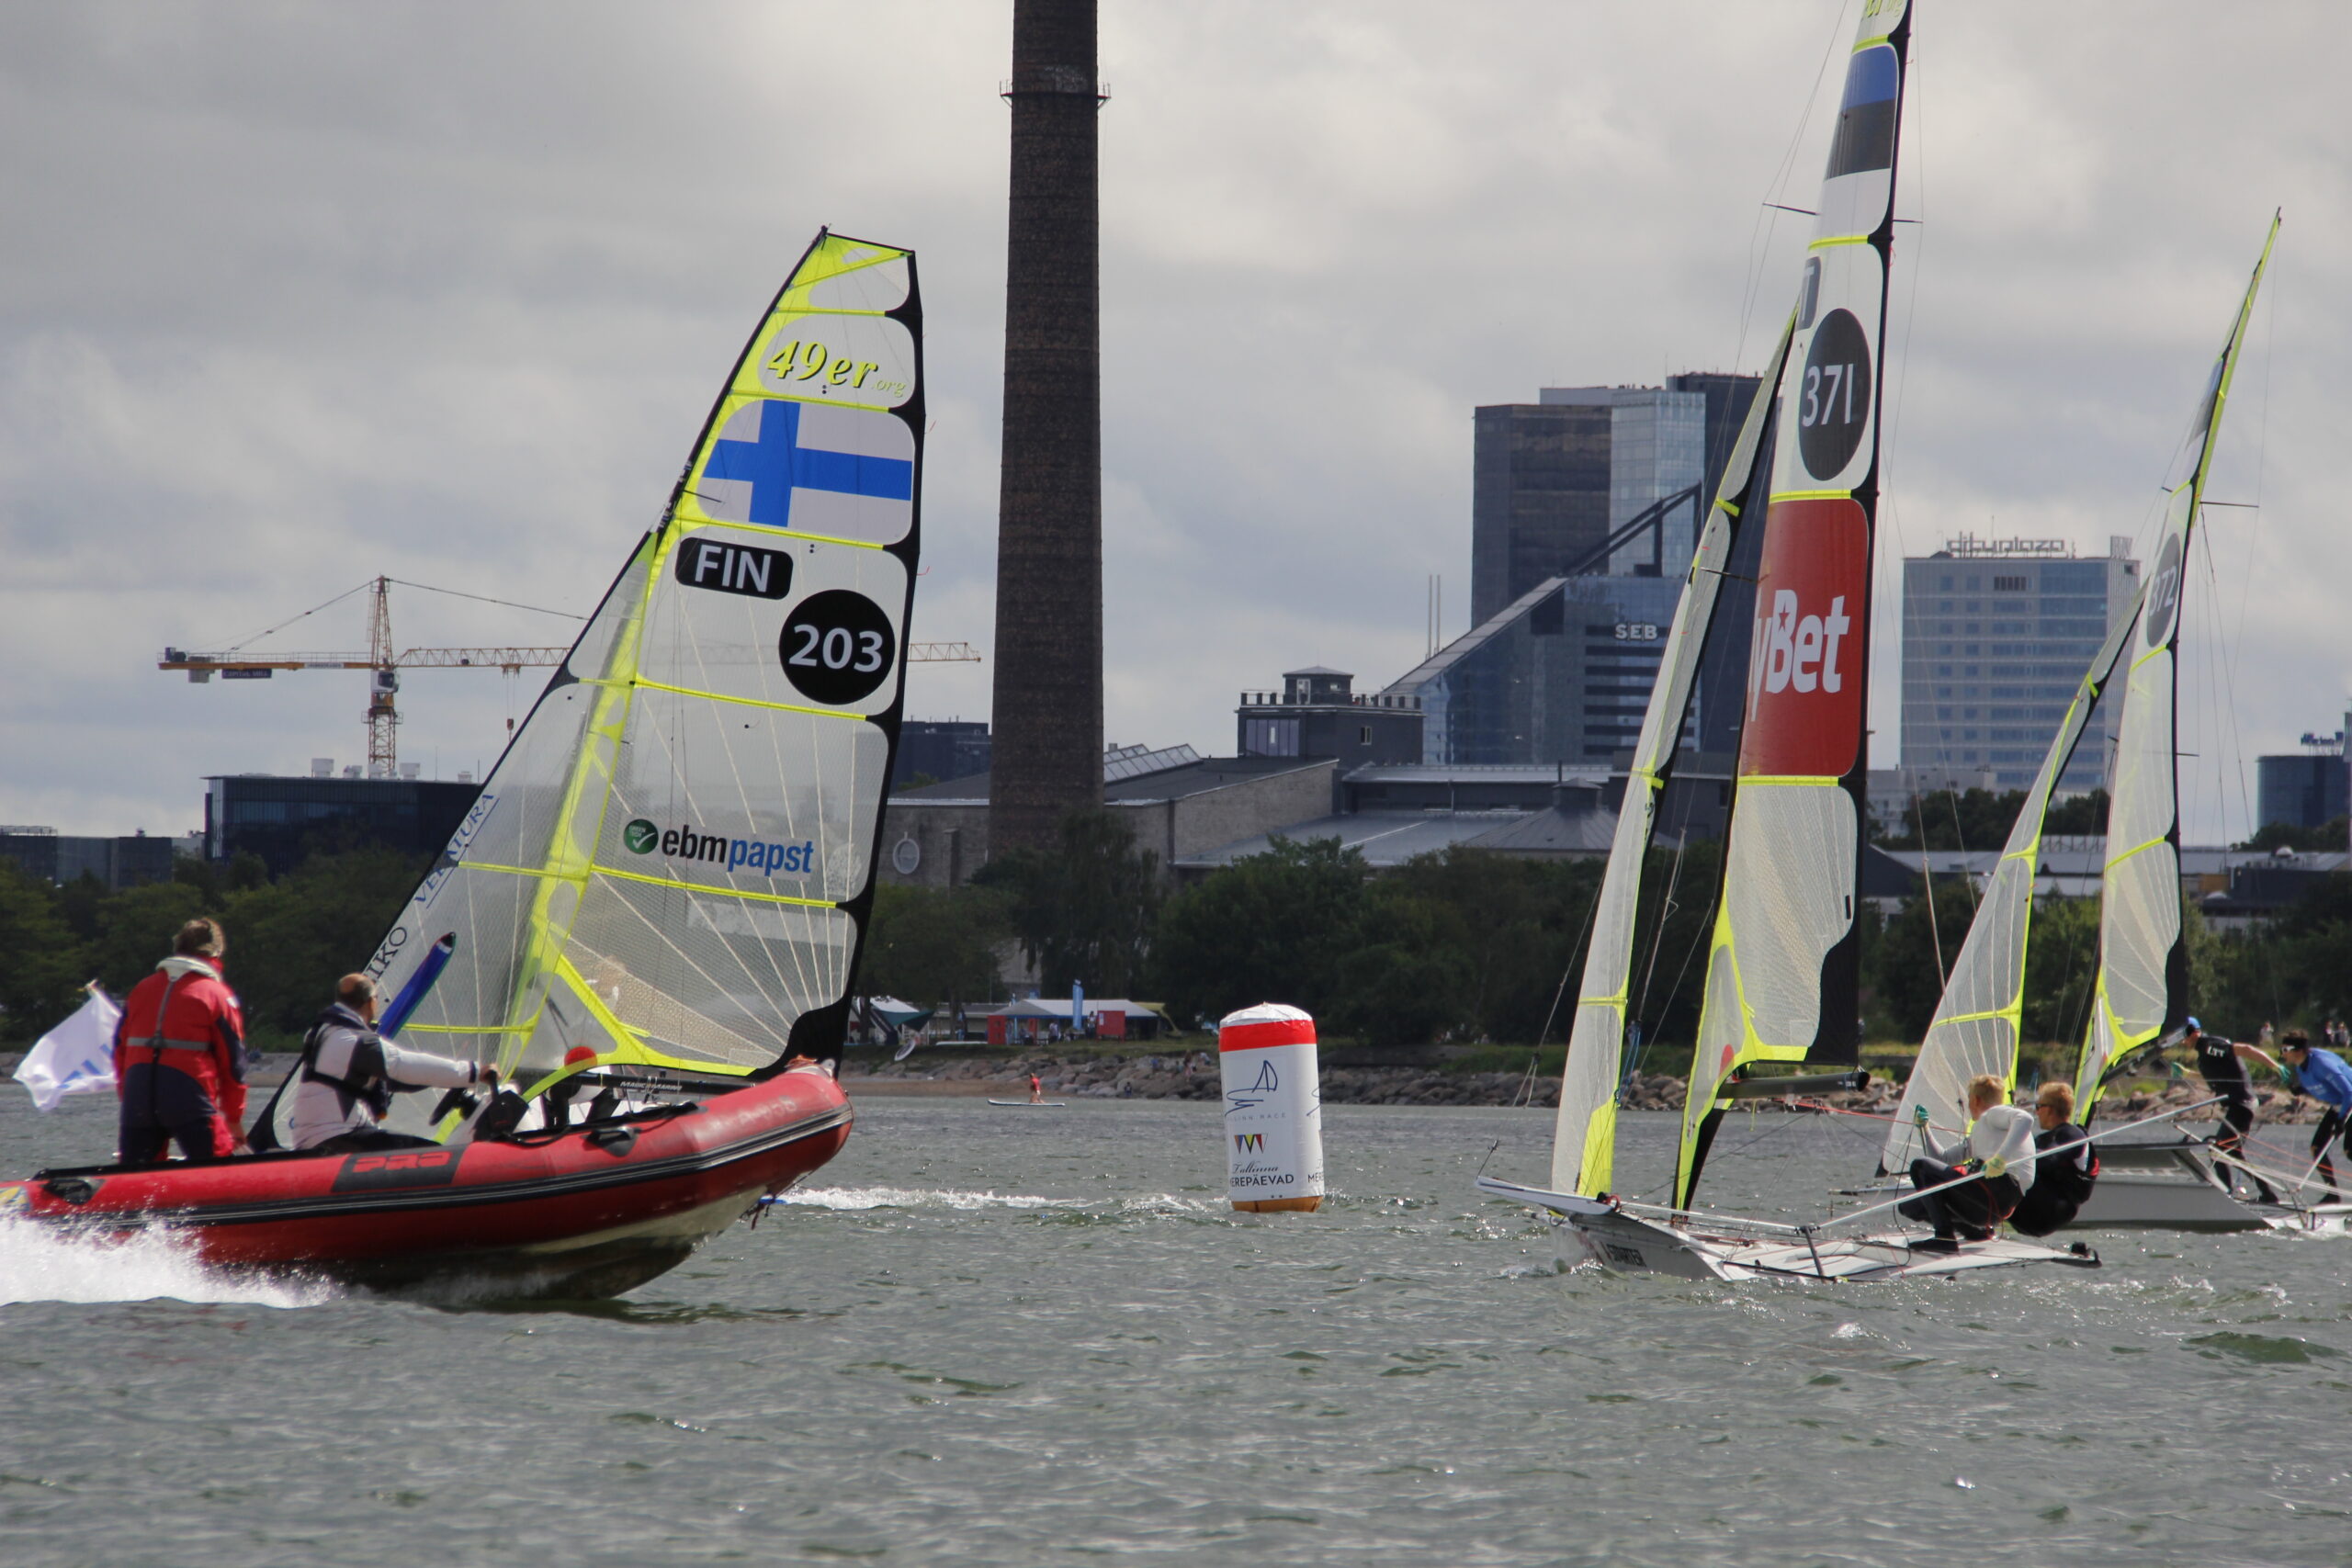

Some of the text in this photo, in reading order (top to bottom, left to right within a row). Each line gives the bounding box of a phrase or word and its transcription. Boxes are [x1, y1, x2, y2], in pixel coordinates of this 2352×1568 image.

[765, 340, 879, 389] 49er
[1802, 363, 1854, 428] 371
[694, 544, 773, 592] FIN
[2149, 565, 2177, 617] 372
[788, 623, 884, 674] 203
[1615, 624, 1657, 640] SEB
[662, 824, 814, 877] ebmpapst
[364, 927, 407, 984] IKO
[353, 1151, 452, 1173] PRO
[1230, 1174, 1295, 1188] EREPÄEVAD
[1233, 1160, 1279, 1174] Tallinna
